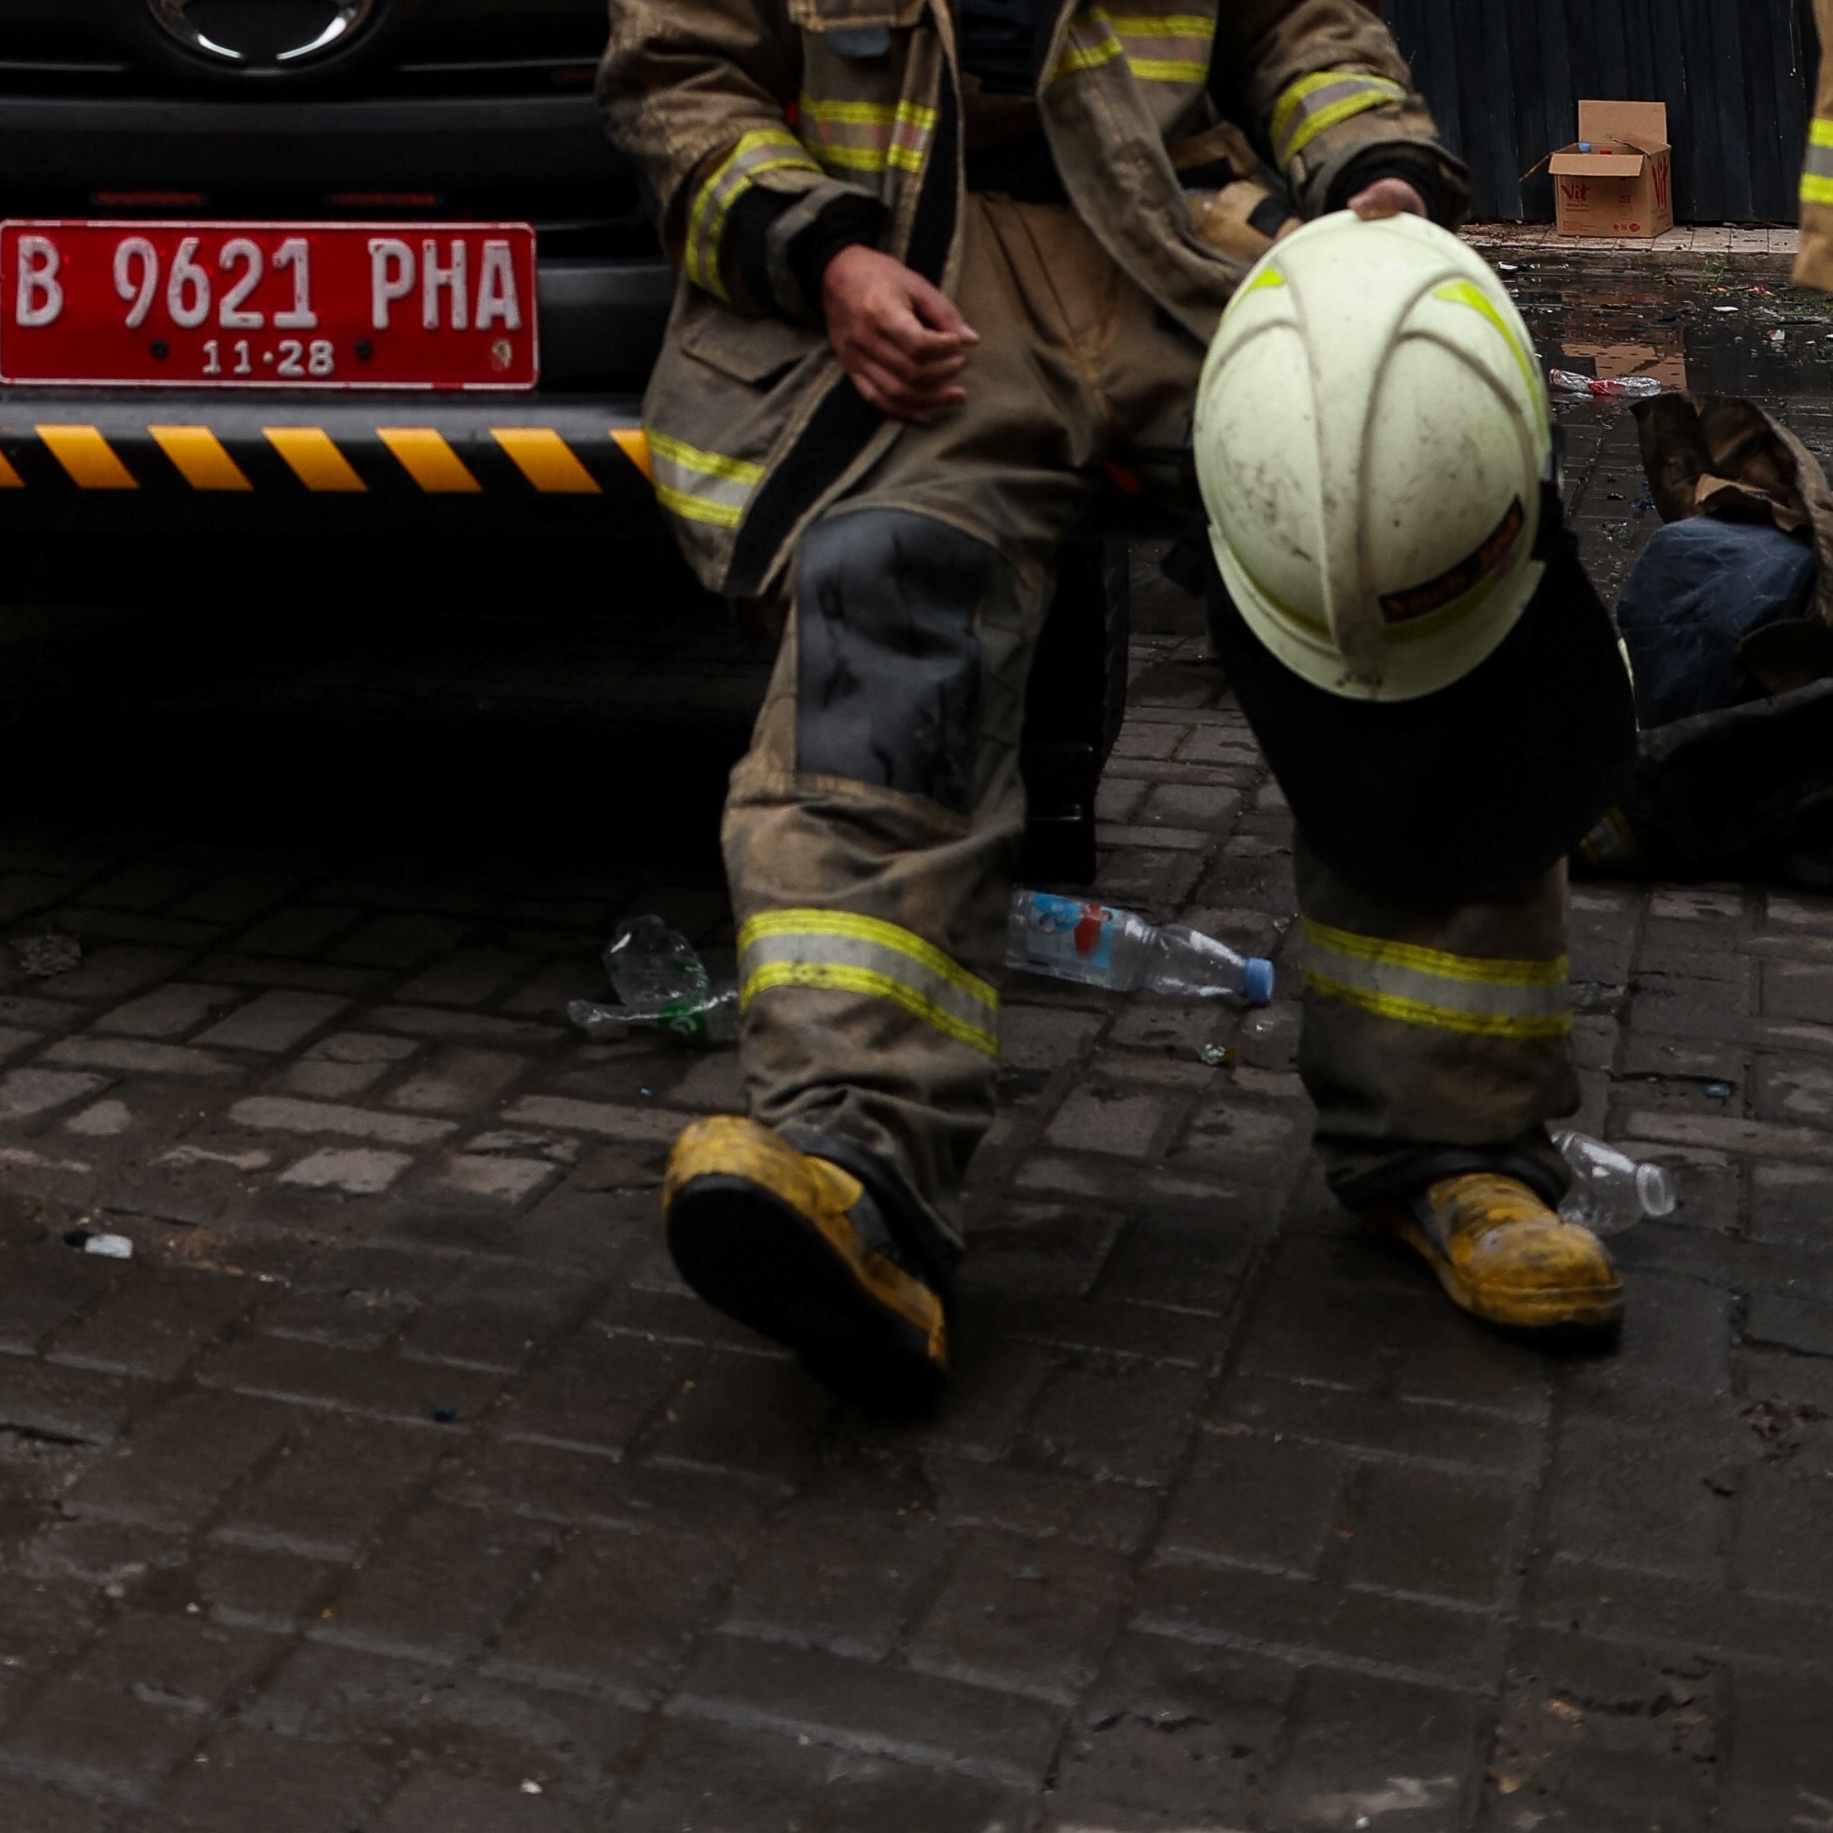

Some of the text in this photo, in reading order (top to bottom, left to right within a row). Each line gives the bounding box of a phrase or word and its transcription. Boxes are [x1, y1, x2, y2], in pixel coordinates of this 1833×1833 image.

[14, 235, 523, 331] B 9621 PHA
